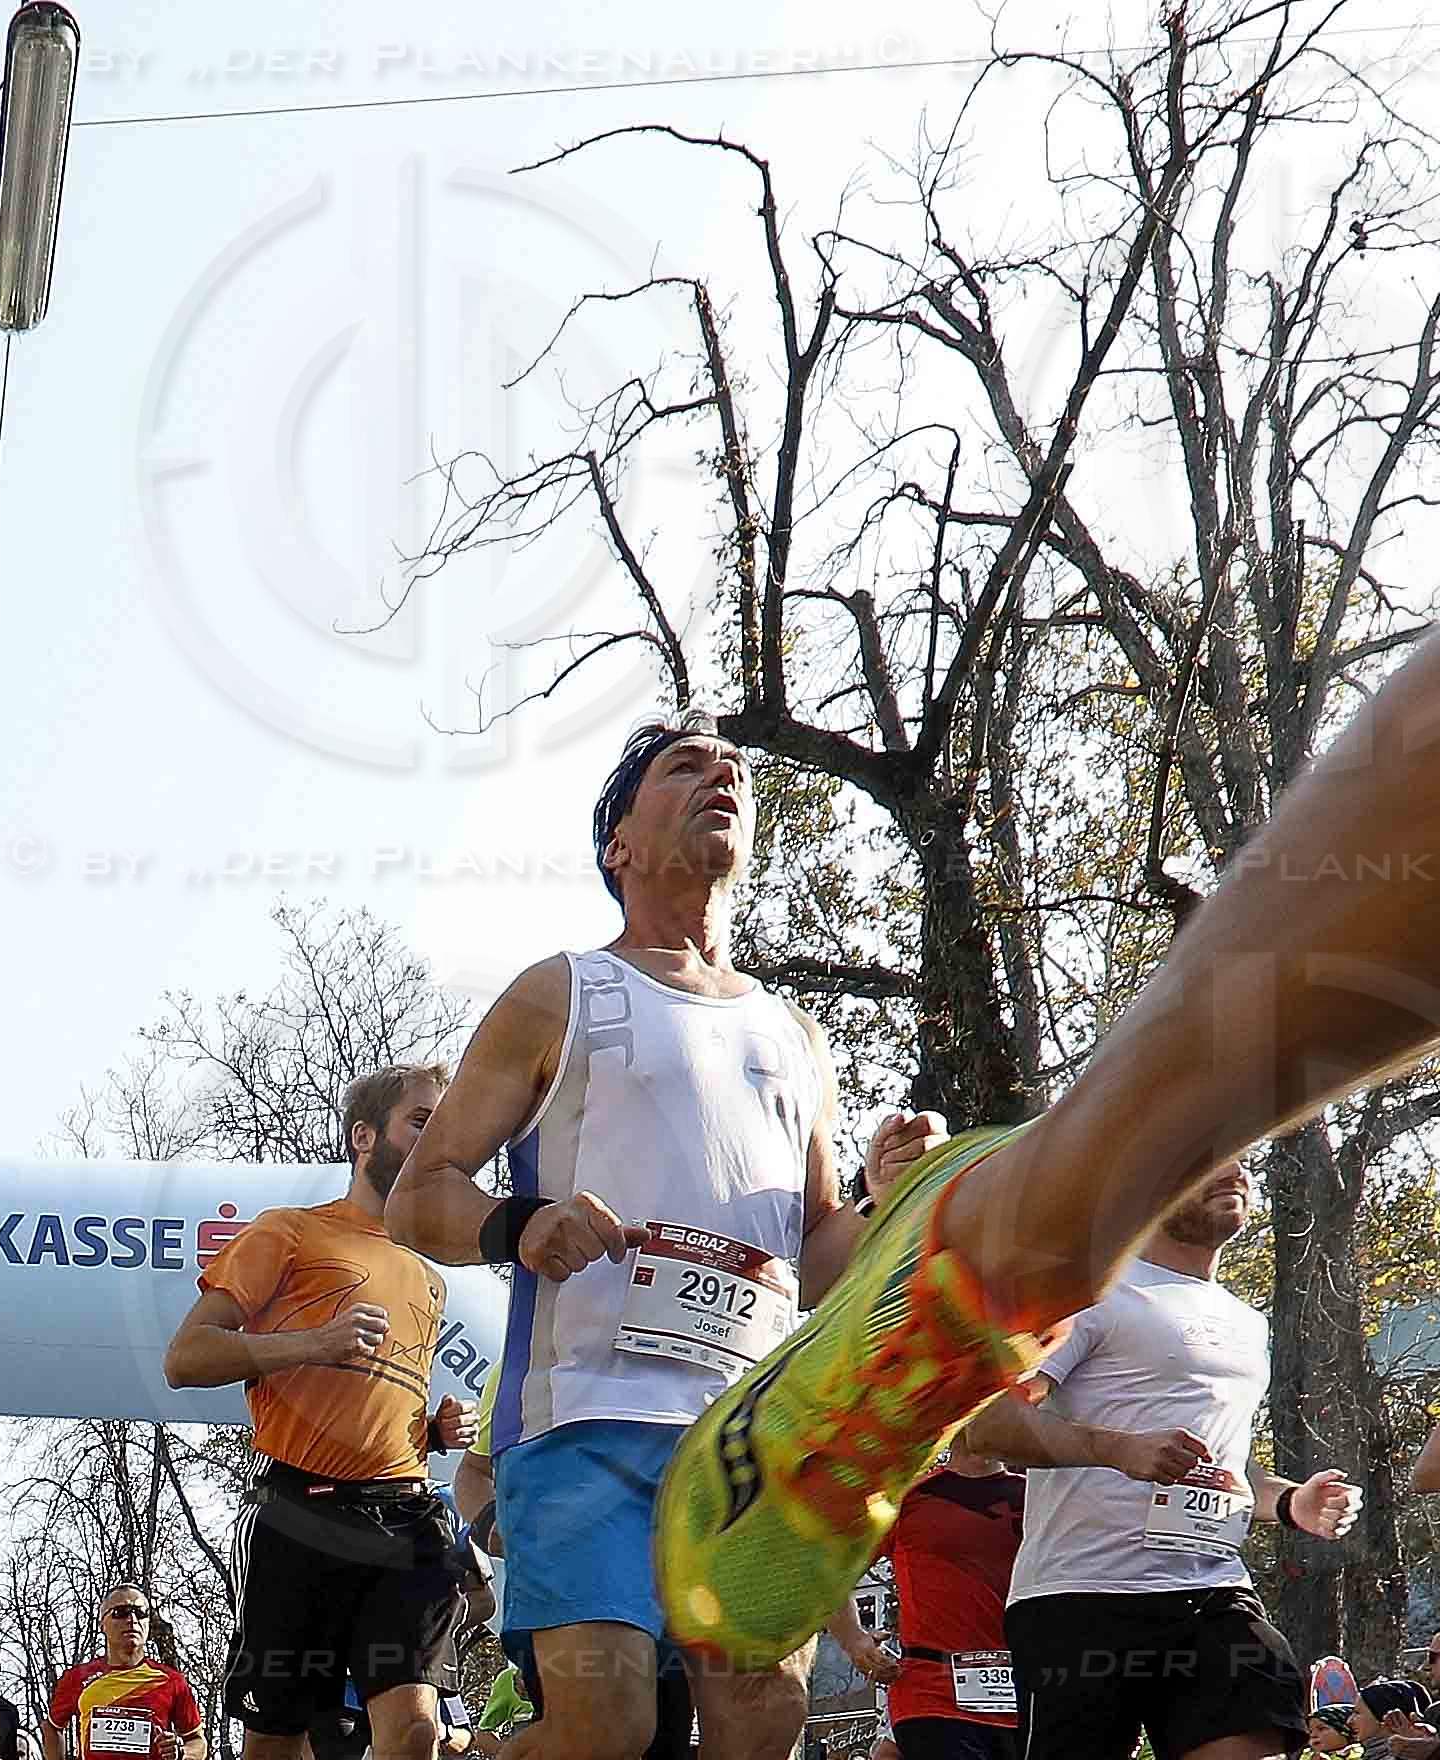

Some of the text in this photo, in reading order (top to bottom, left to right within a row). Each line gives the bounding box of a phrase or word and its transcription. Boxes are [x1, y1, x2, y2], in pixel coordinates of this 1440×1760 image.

[686, 1232, 730, 1253] GRAZ
[676, 1270, 758, 1320] 2912
[694, 1318, 732, 1338] Josef
[1183, 1489, 1233, 1518] 2011
[105, 1720, 136, 1732] 2738
